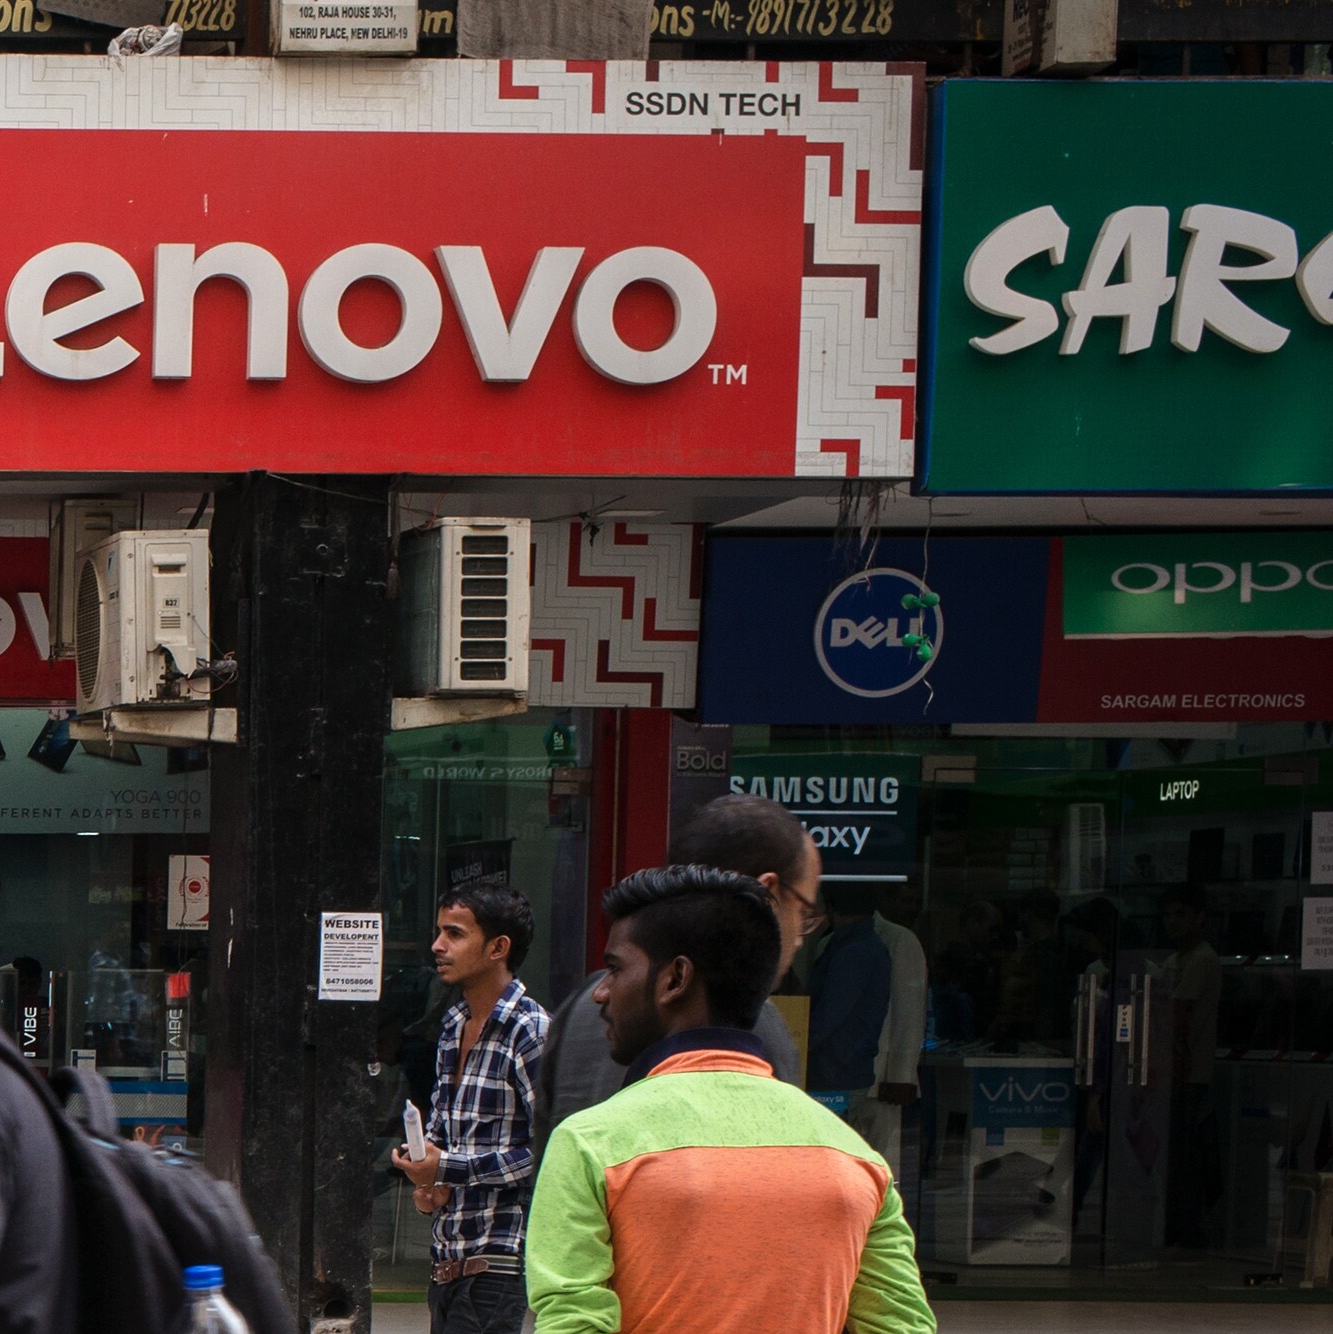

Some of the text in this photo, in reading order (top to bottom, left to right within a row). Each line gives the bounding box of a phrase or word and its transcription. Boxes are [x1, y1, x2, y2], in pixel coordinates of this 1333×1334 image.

[299, 6, 397, 20] 102, RAJA HOUSE 30-31,
[289, 27, 408, 42] NEHRU PLACE, NEW DELHI-19
[625, 91, 801, 117] SSDN TECH
[830, 616, 931, 650] DELL
[1100, 693, 1306, 709] SARGAM ELECTRONICS
[676, 751, 727, 771] Bold
[110, 789, 202, 805] YOGA 900
[730, 775, 899, 804] SAMSUNG
[1159, 780, 1200, 801] LAPTOP
[70, 807, 134, 819] ADAPTS
[141, 807, 202, 819] BETTER
[325, 919, 379, 929] WEBSITE
[24, 1006, 37, 1046] VIBE
[980, 1076, 1071, 1102] vivo
[988, 1104, 1023, 1114] Camera
